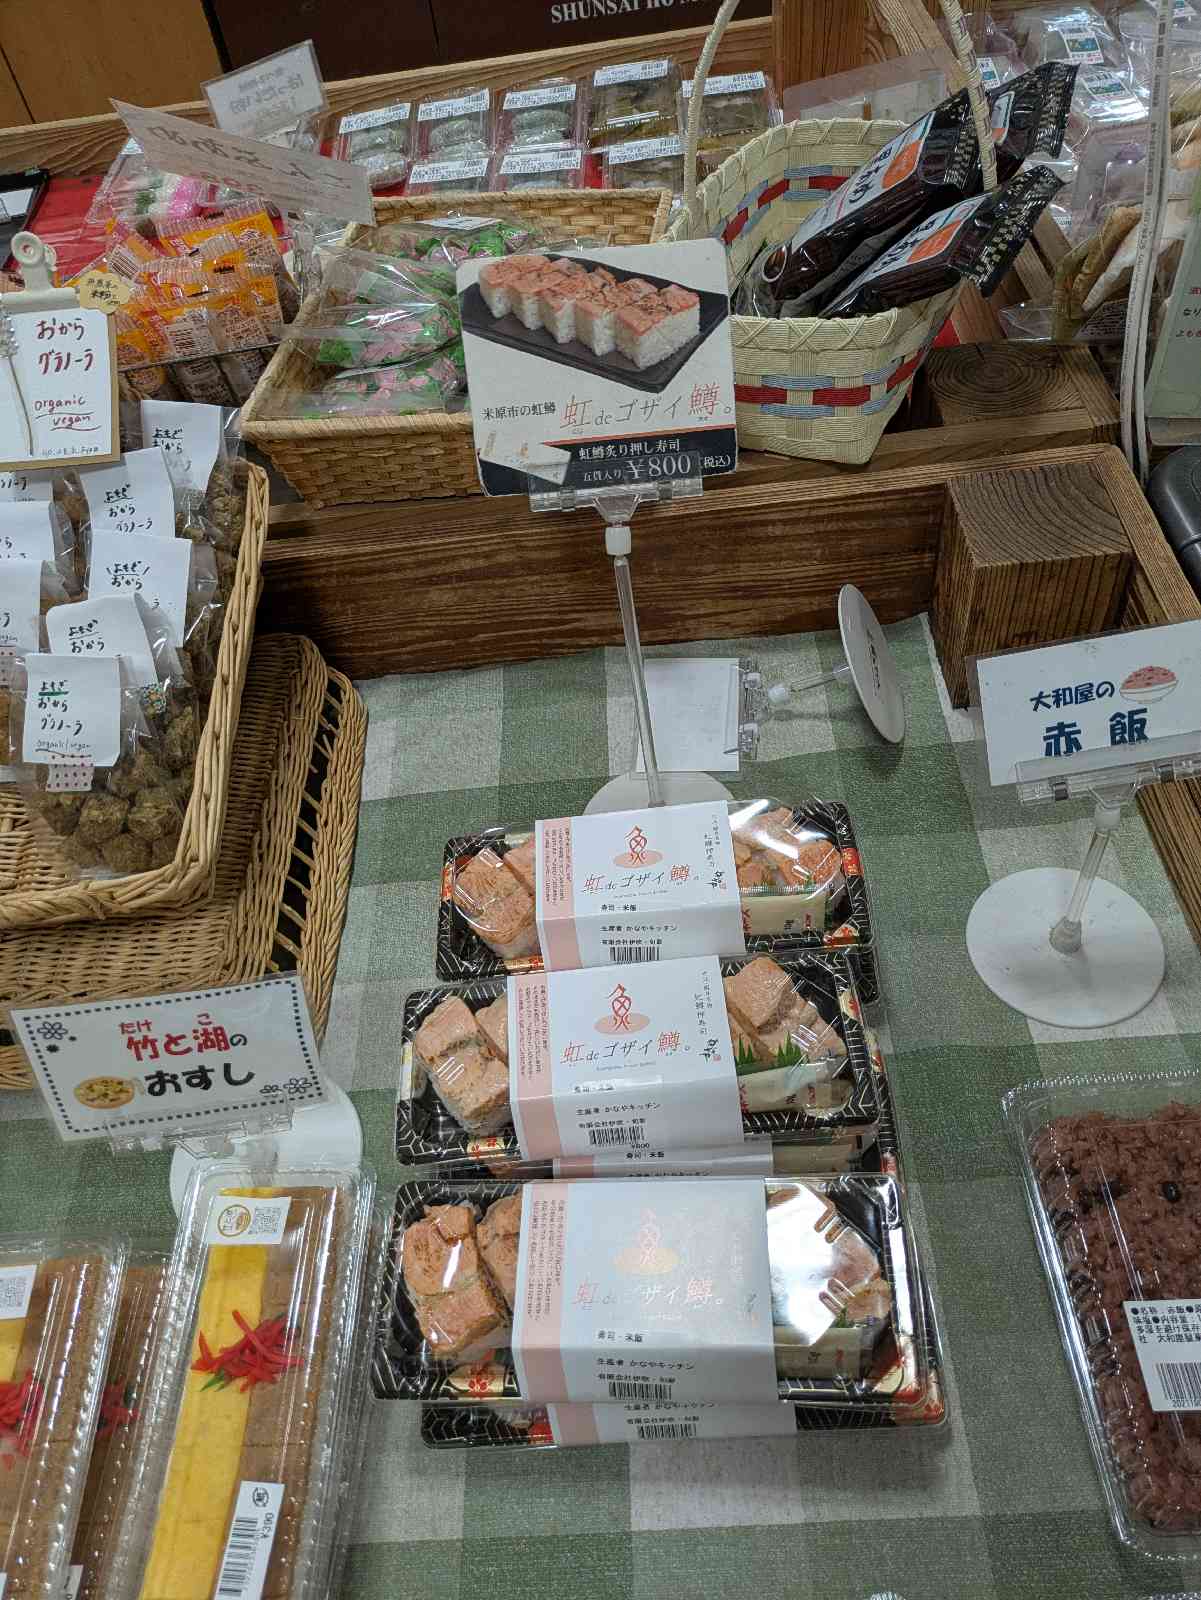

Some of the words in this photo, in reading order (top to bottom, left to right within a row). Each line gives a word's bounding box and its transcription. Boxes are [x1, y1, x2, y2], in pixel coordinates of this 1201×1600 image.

[36, 318, 85, 341] おから
[38, 349, 94, 375] グラノーラ
[35, 395, 86, 414] organic
[482, 401, 557, 421] 米原市の虹鱒
[53, 415, 91, 430] vegan
[578, 438, 681, 461] 虹鱒炙り押し寿司
[699, 454, 731, 469] 税込)
[108, 505, 137, 519] おから
[110, 574, 144, 590] おから
[71, 637, 105, 654] おから
[37, 697, 69, 713] おから
[1030, 680, 1115, 712] 大和屋の
[118, 1018, 153, 1035] たけ
[197, 1012, 213, 1025] こ
[126, 1025, 248, 1062] 竹と湖の
[144, 1062, 256, 1098] おすし
